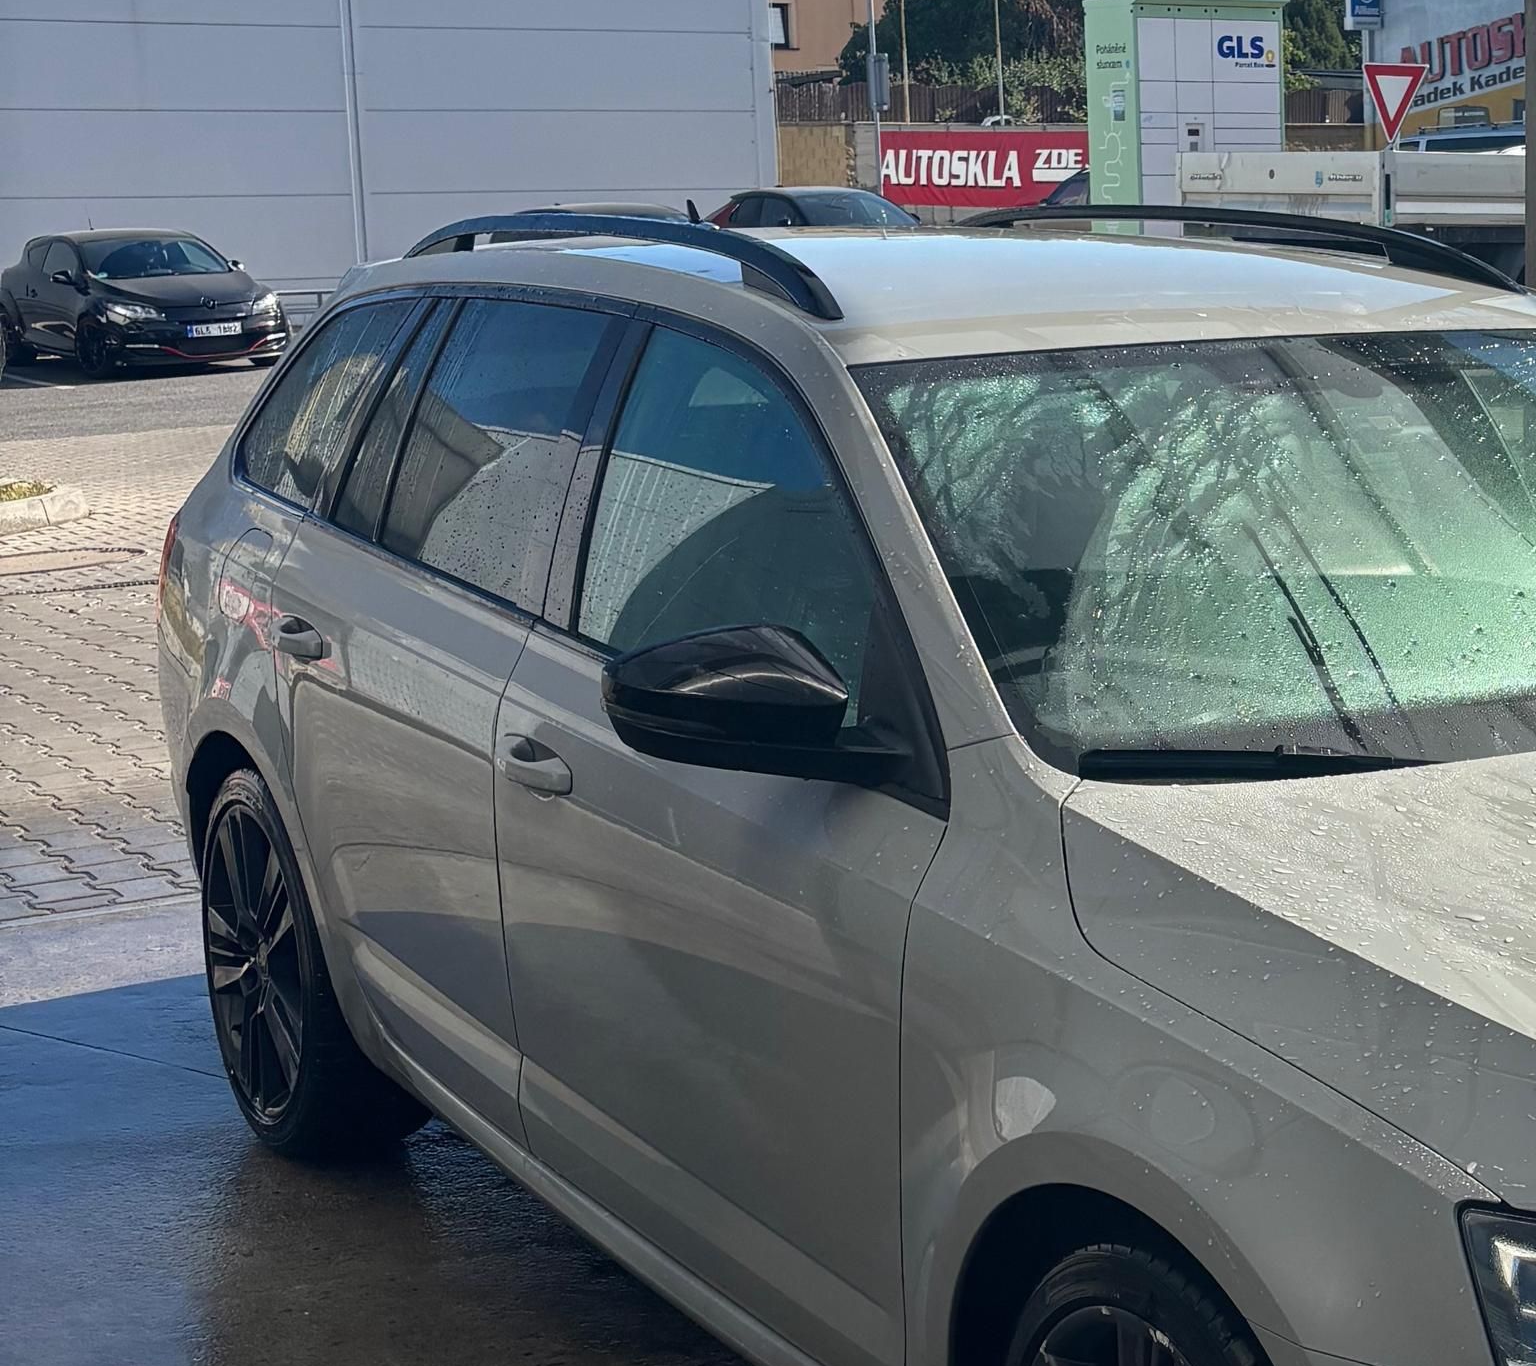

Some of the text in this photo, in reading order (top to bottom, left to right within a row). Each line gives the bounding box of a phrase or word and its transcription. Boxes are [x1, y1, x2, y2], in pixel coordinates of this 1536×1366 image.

[1217, 35, 1265, 59] GLS
[1412, 81, 1465, 108] adek
[881, 149, 1022, 188] AUTOSKLA
